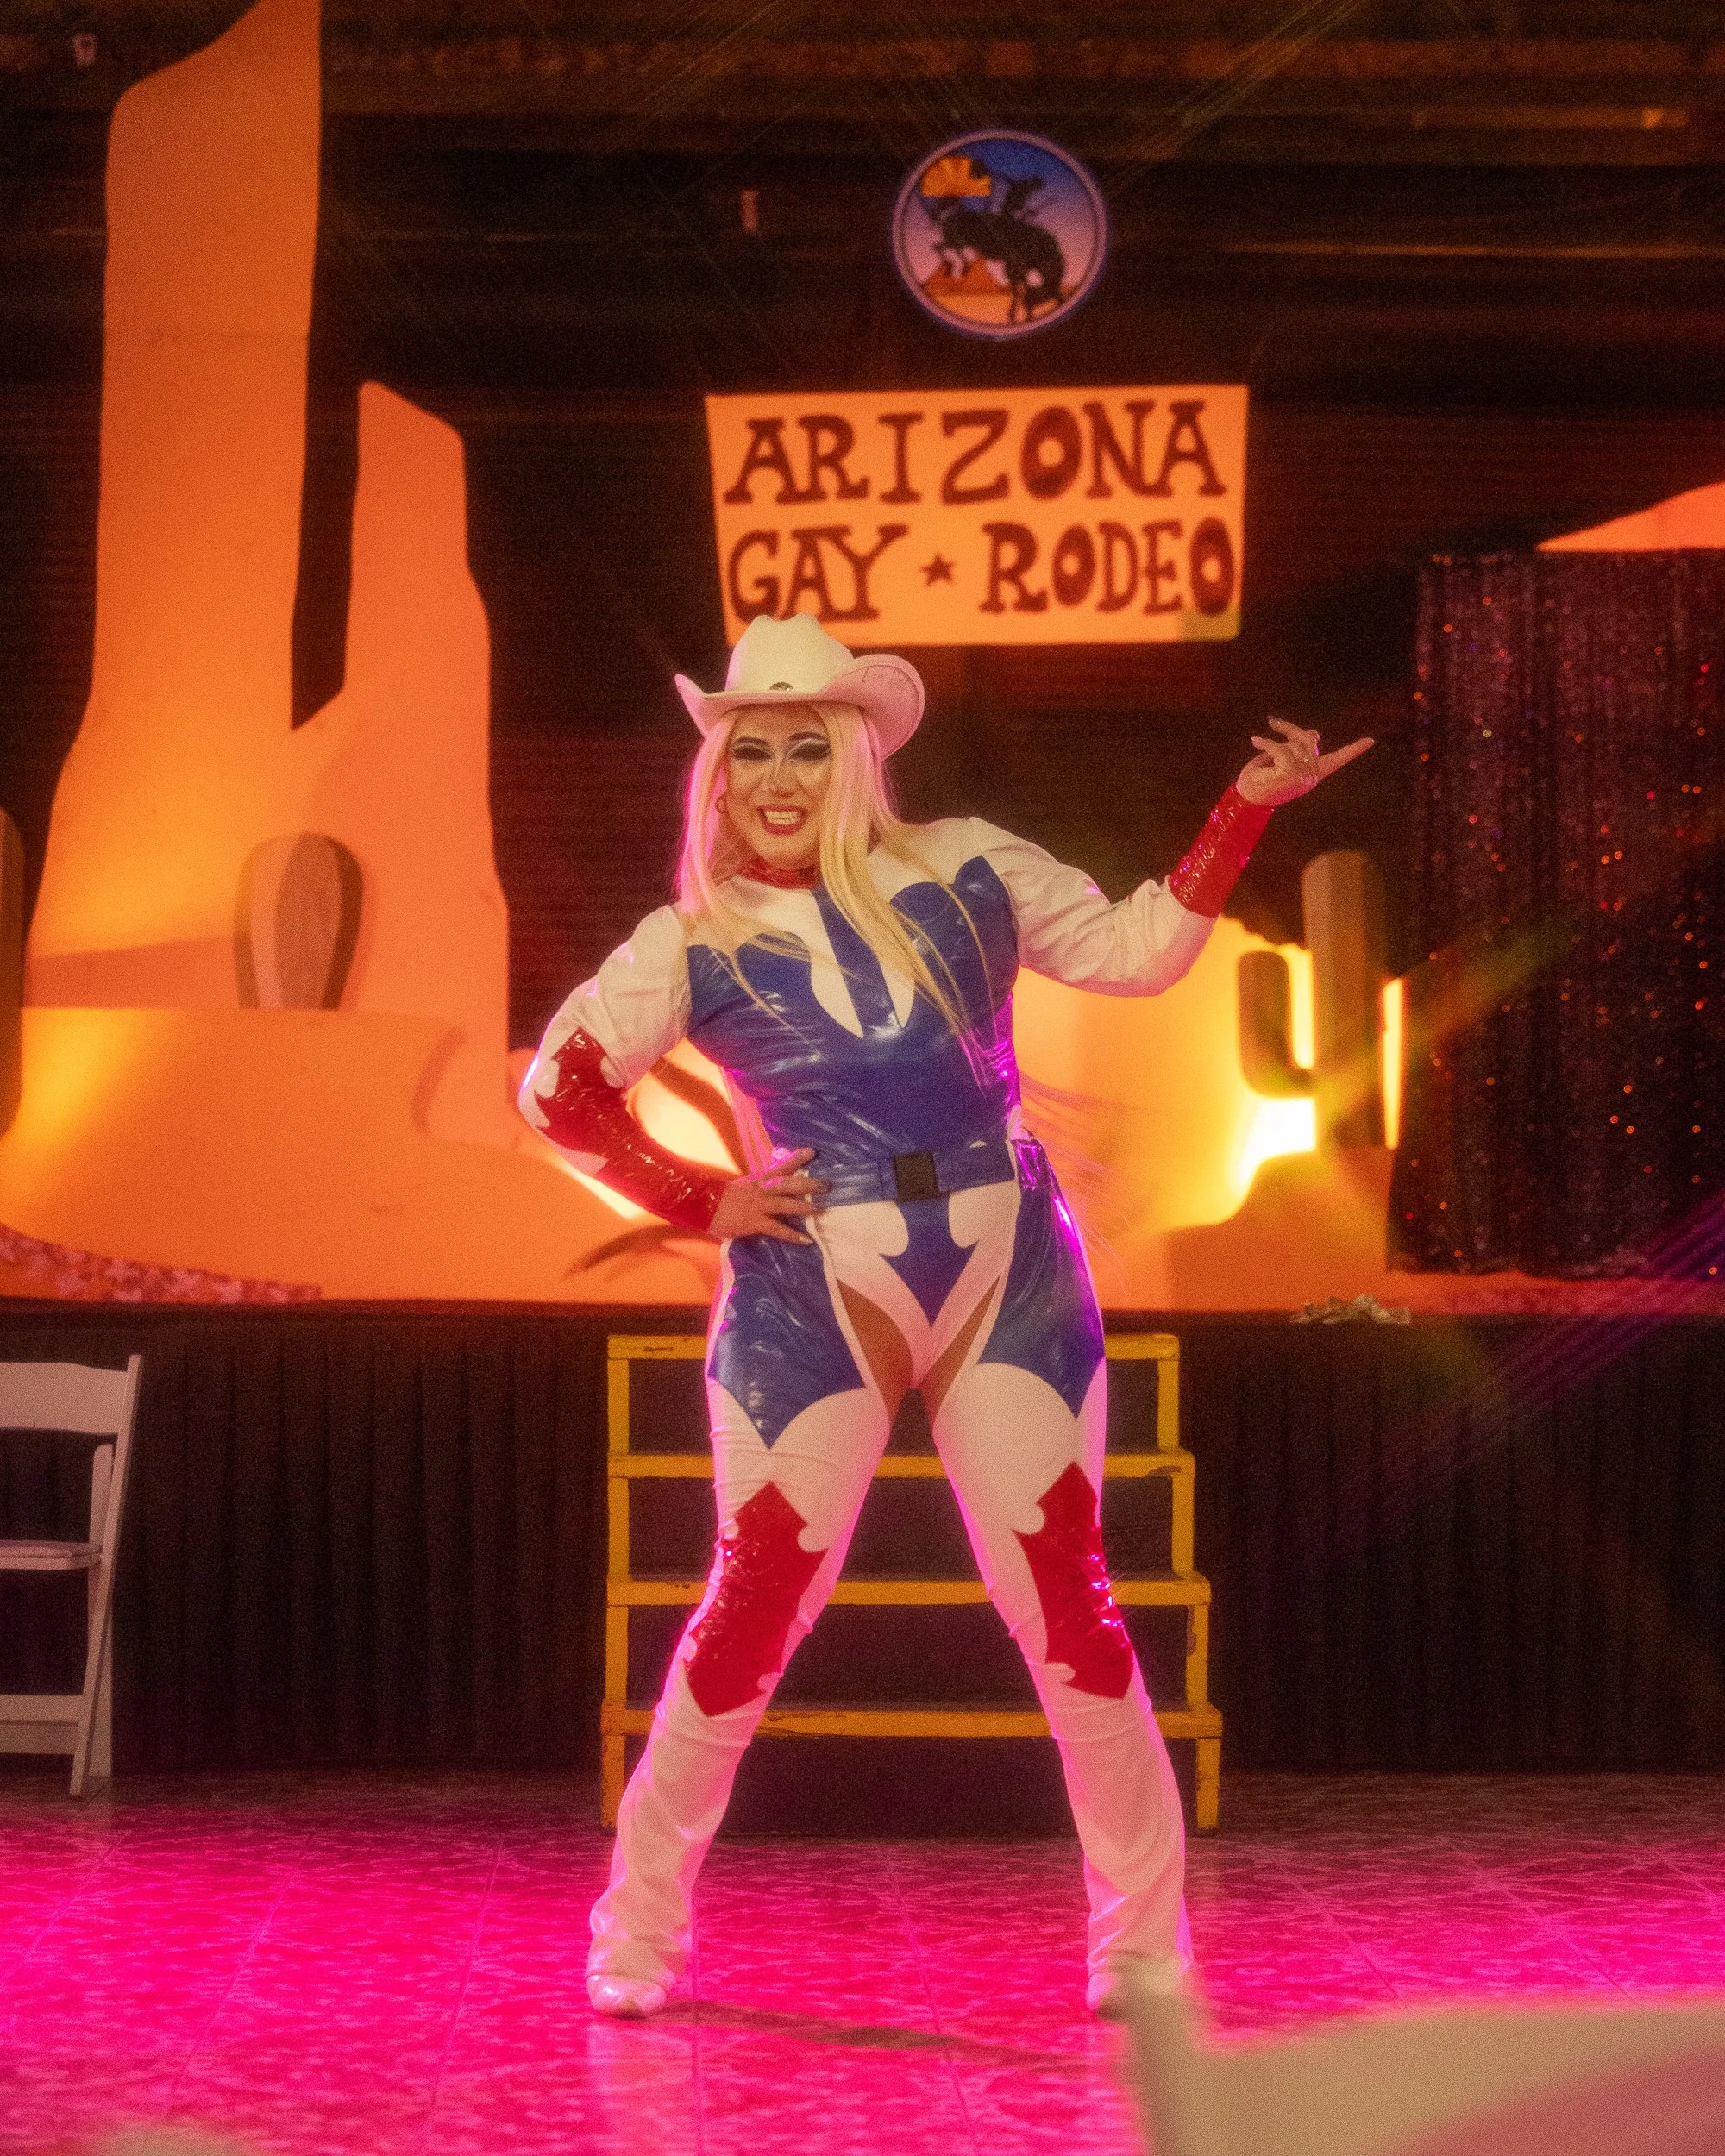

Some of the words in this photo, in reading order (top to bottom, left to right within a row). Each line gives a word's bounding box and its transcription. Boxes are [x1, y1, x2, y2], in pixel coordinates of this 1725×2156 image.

[724, 400, 1228, 505] ARIZONA
[728, 523, 909, 623] GAY
[979, 517, 1235, 617] RODEO
